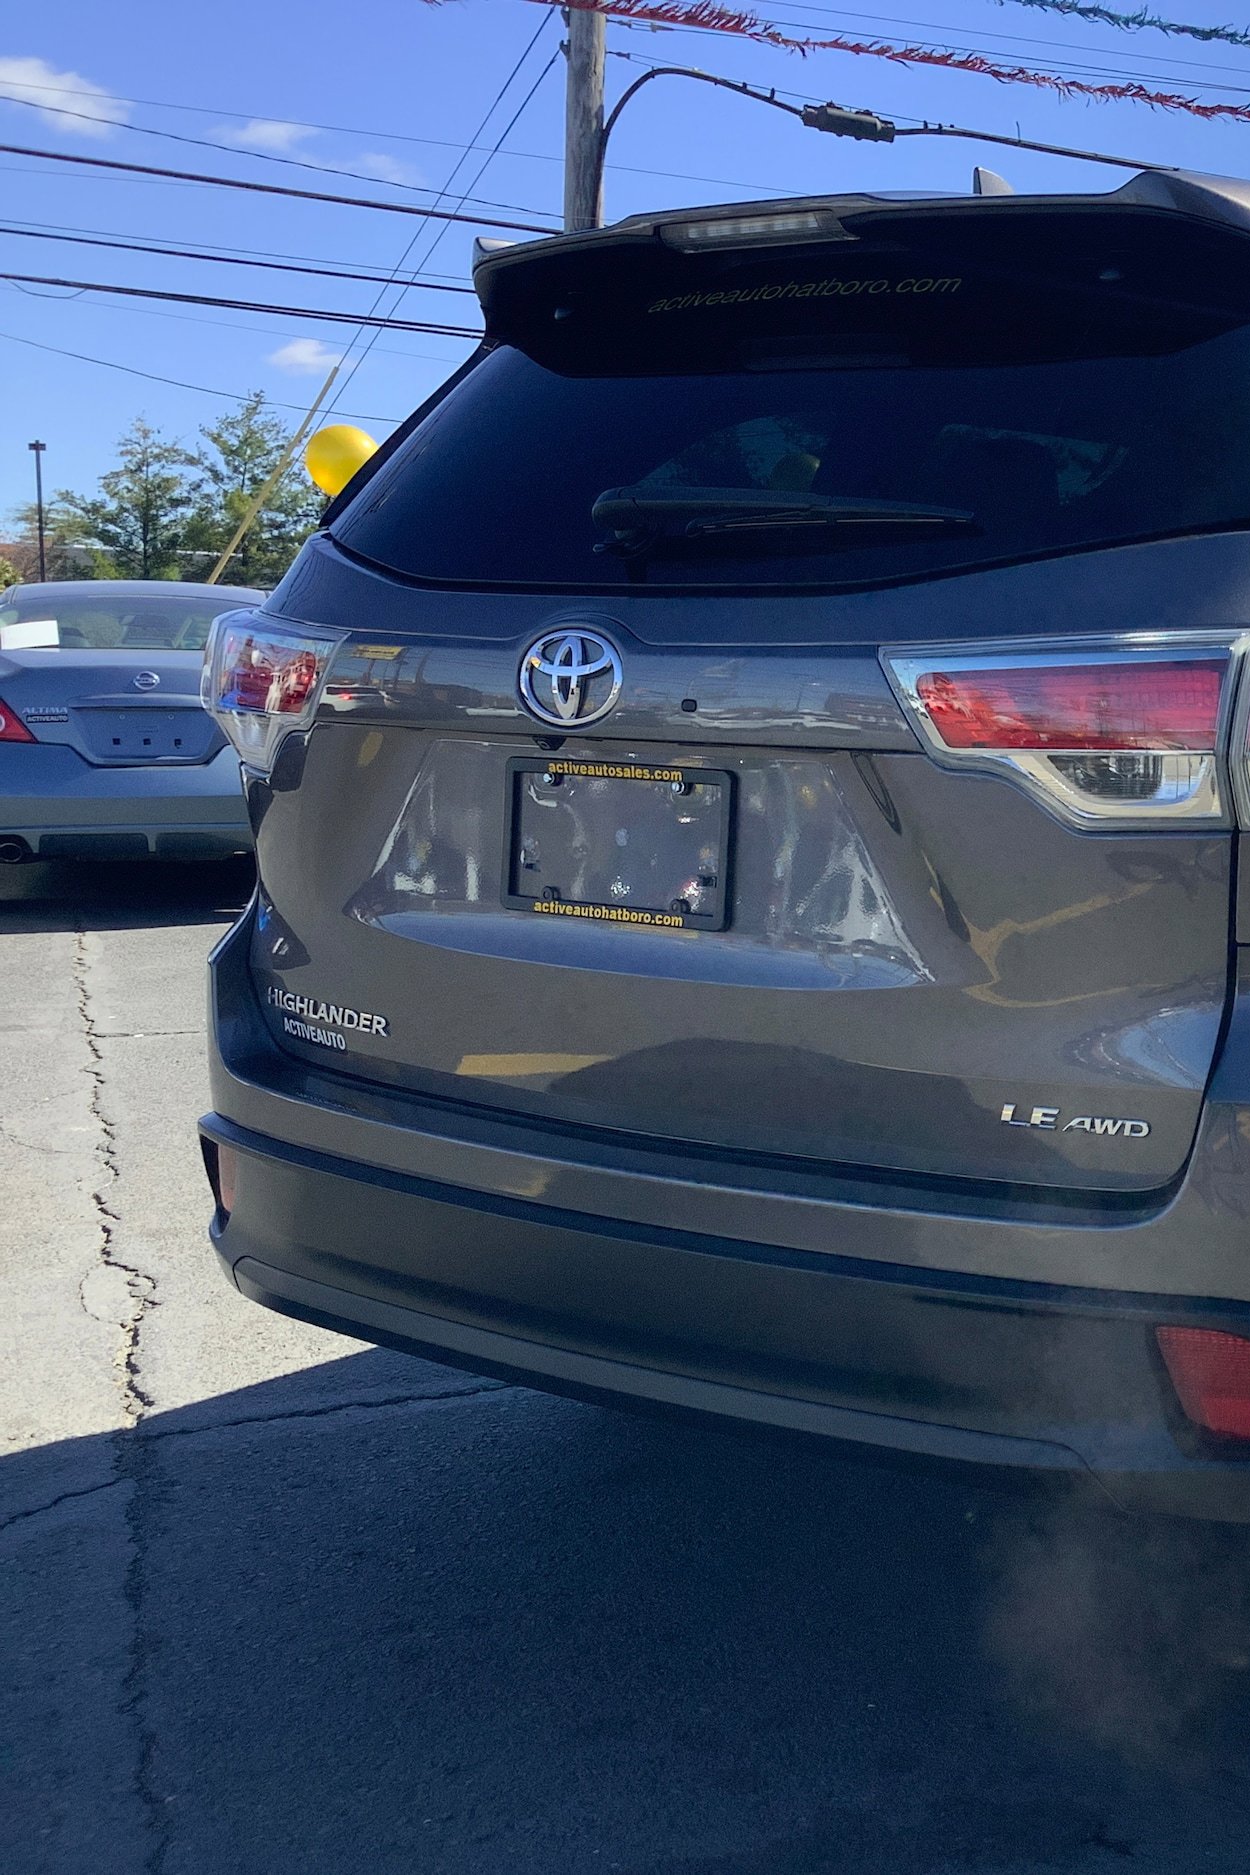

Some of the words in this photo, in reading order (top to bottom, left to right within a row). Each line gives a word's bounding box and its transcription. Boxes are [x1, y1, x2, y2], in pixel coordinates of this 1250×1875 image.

[648, 277, 962, 313] activeautohatboro.com
[22, 706, 68, 714] ALTIMA
[548, 761, 683, 782] activeautosales.com
[534, 900, 684, 928] activeautohatboro.com
[268, 986, 388, 1037] HIGHLANDER
[284, 1017, 346, 1050] ACTIVEAUTO
[1000, 1103, 1060, 1130] LE
[1062, 1116, 1150, 1138] AWD
